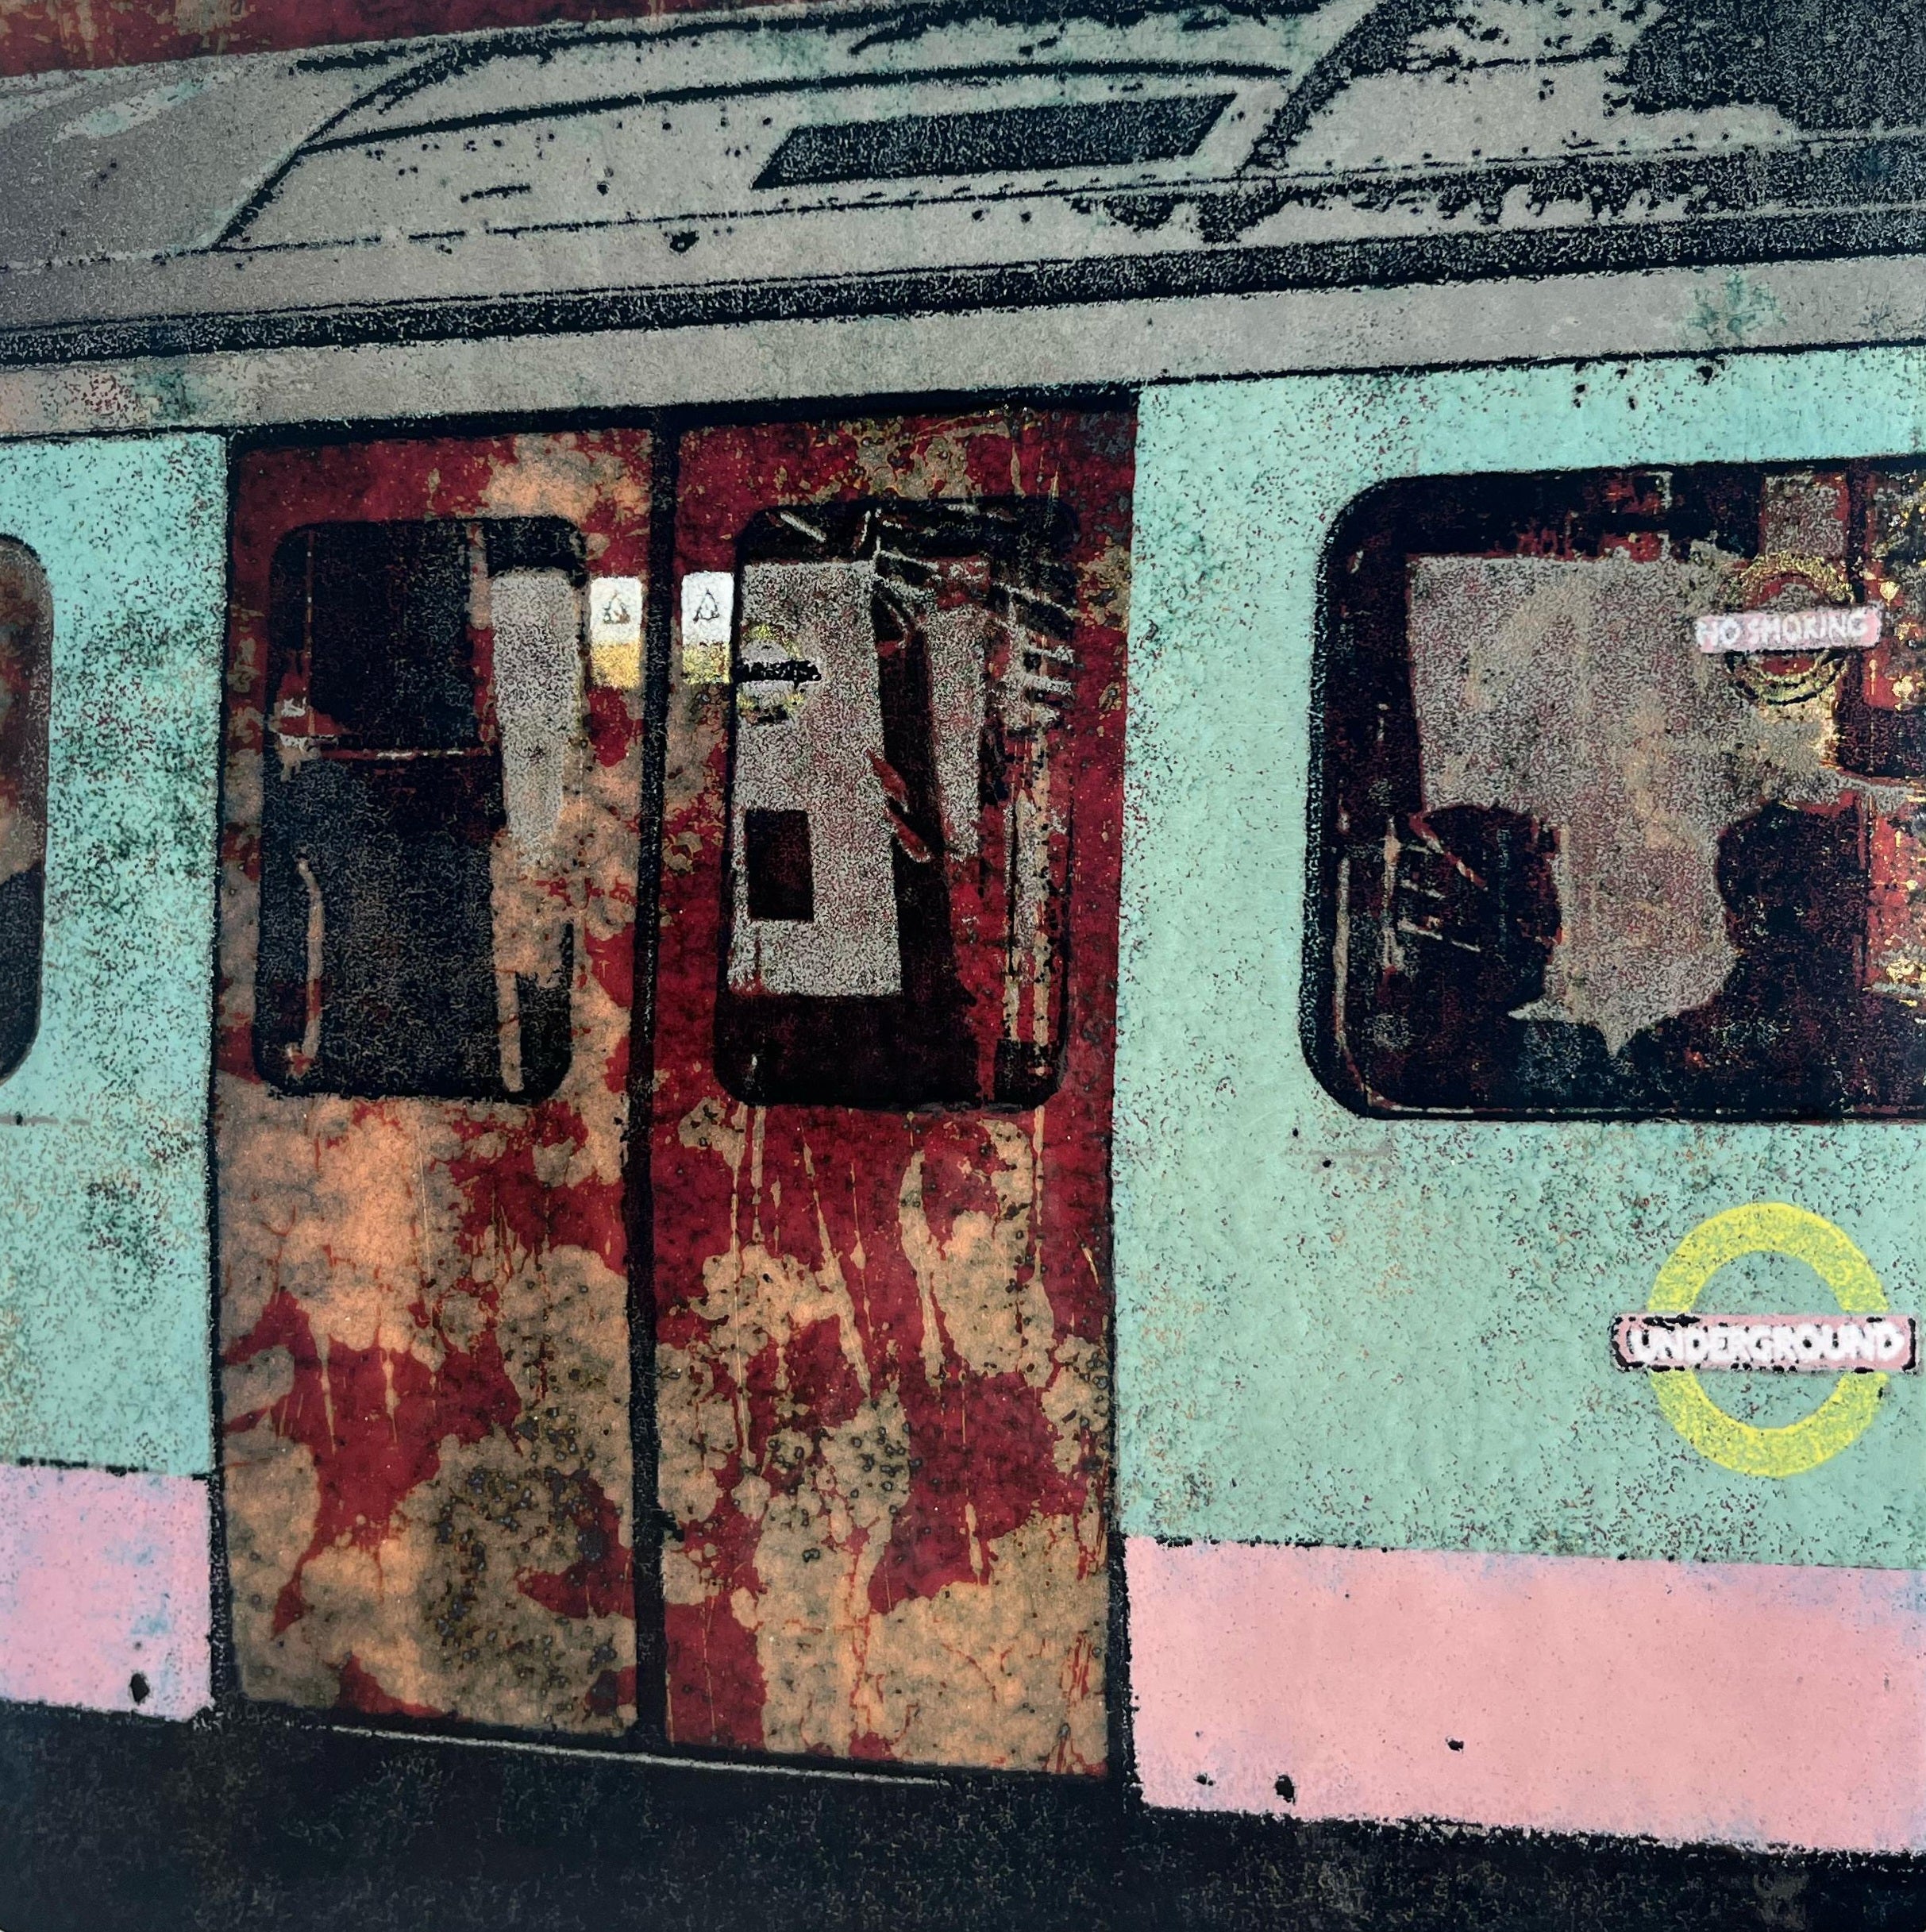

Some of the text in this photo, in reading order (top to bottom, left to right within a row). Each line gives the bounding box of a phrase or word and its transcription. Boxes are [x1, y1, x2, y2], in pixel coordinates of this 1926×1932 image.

[1694, 608, 1869, 646] NO SMOKING
[1627, 1321, 1905, 1363] UNDERGROUND
